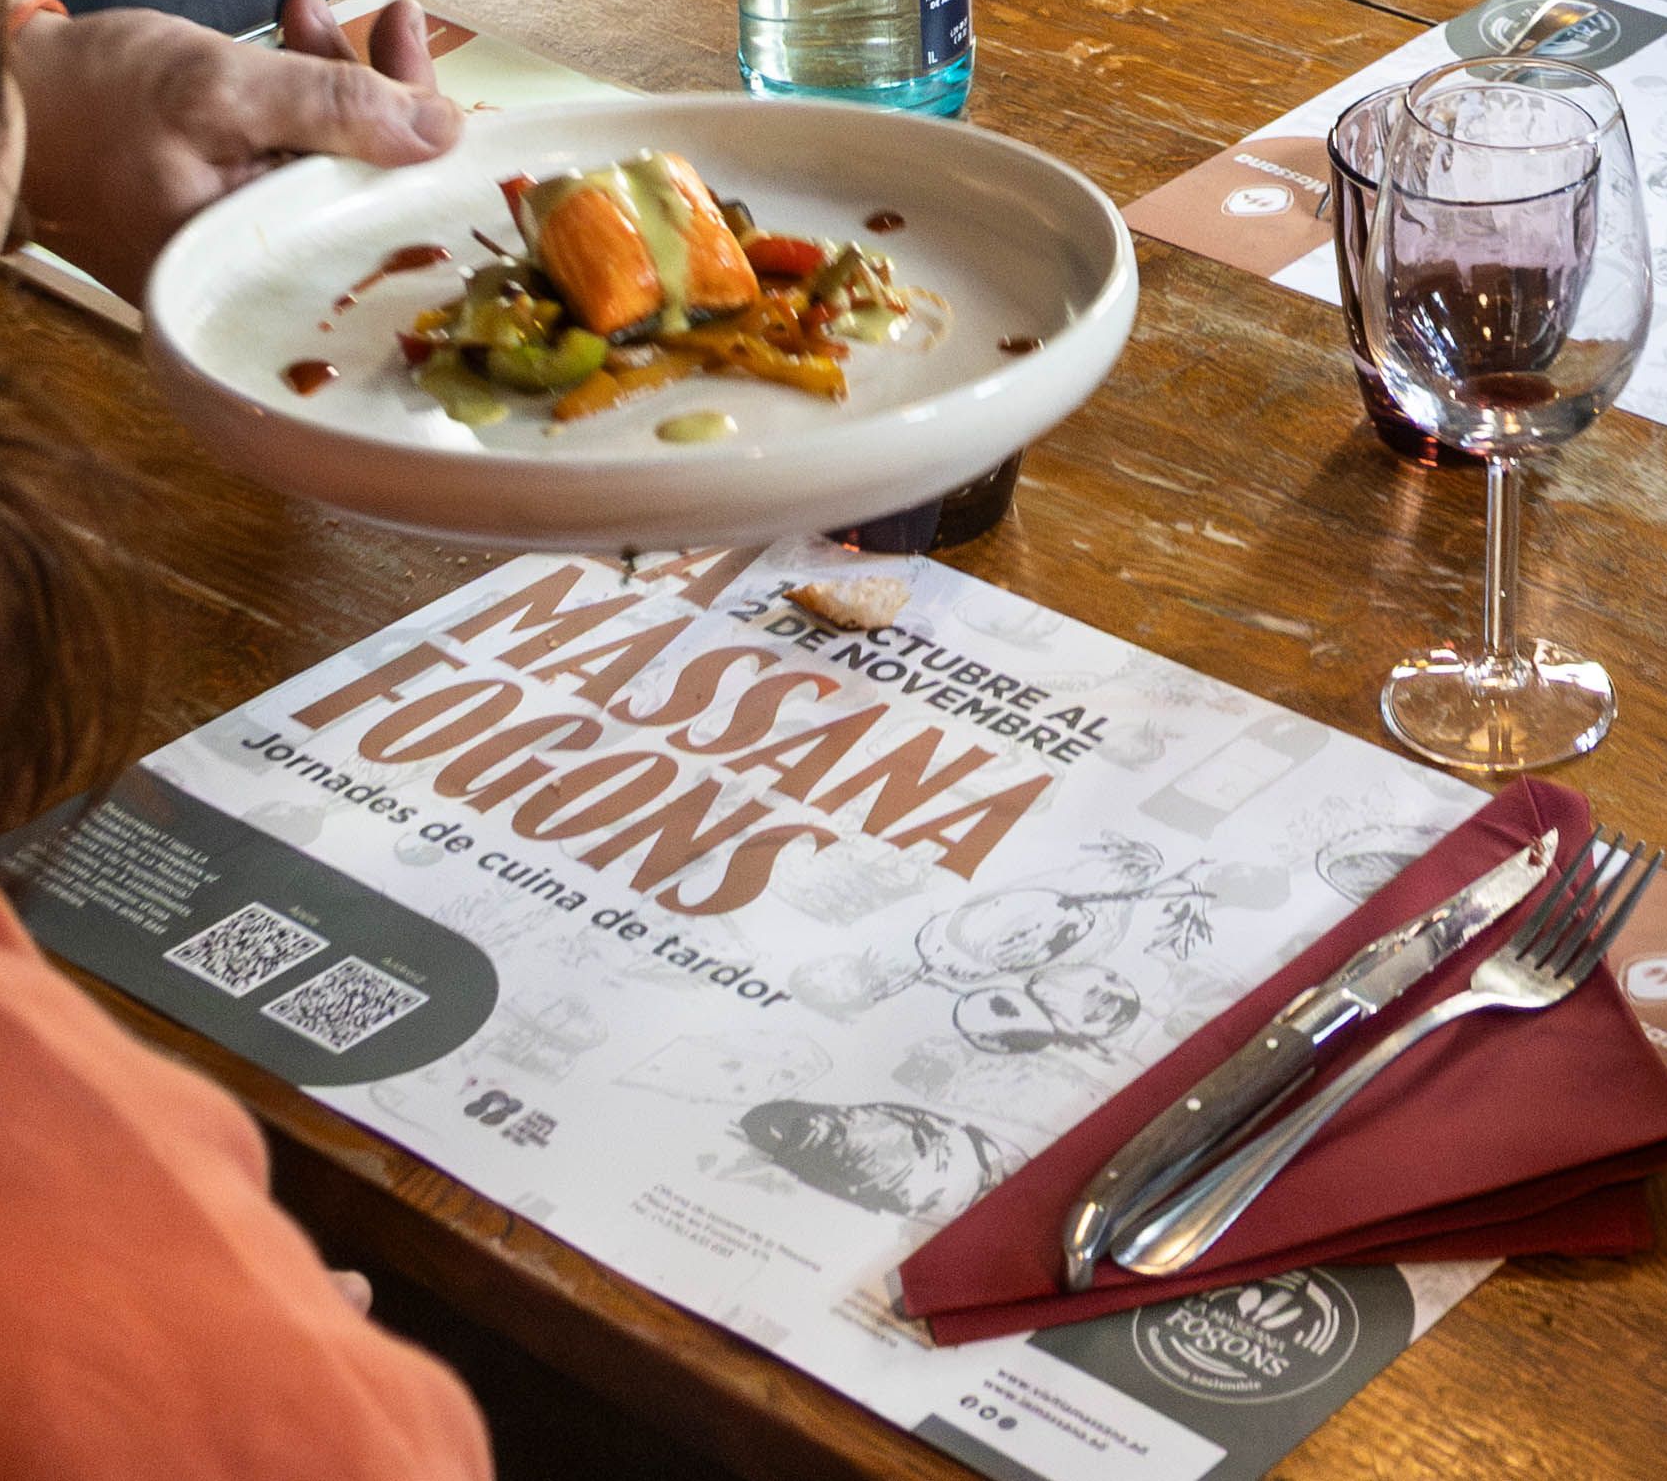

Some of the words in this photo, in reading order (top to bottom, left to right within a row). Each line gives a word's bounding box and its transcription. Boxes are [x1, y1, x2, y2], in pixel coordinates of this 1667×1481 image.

[289, 640, 840, 917] FOGONS
[444, 563, 1054, 882] MASSANA
[728, 600, 770, 624] 2
[764, 616, 838, 654] DE
[830, 641, 1098, 768] NOVEMBRE
[1044, 705, 1114, 745] AL
[243, 731, 418, 825] Jornades
[420, 814, 475, 855] de
[477, 848, 587, 914] cuina
[592, 894, 651, 944] de
[650, 932, 795, 1010] tardor
[1164, 1306, 1291, 1378] FOGONS
